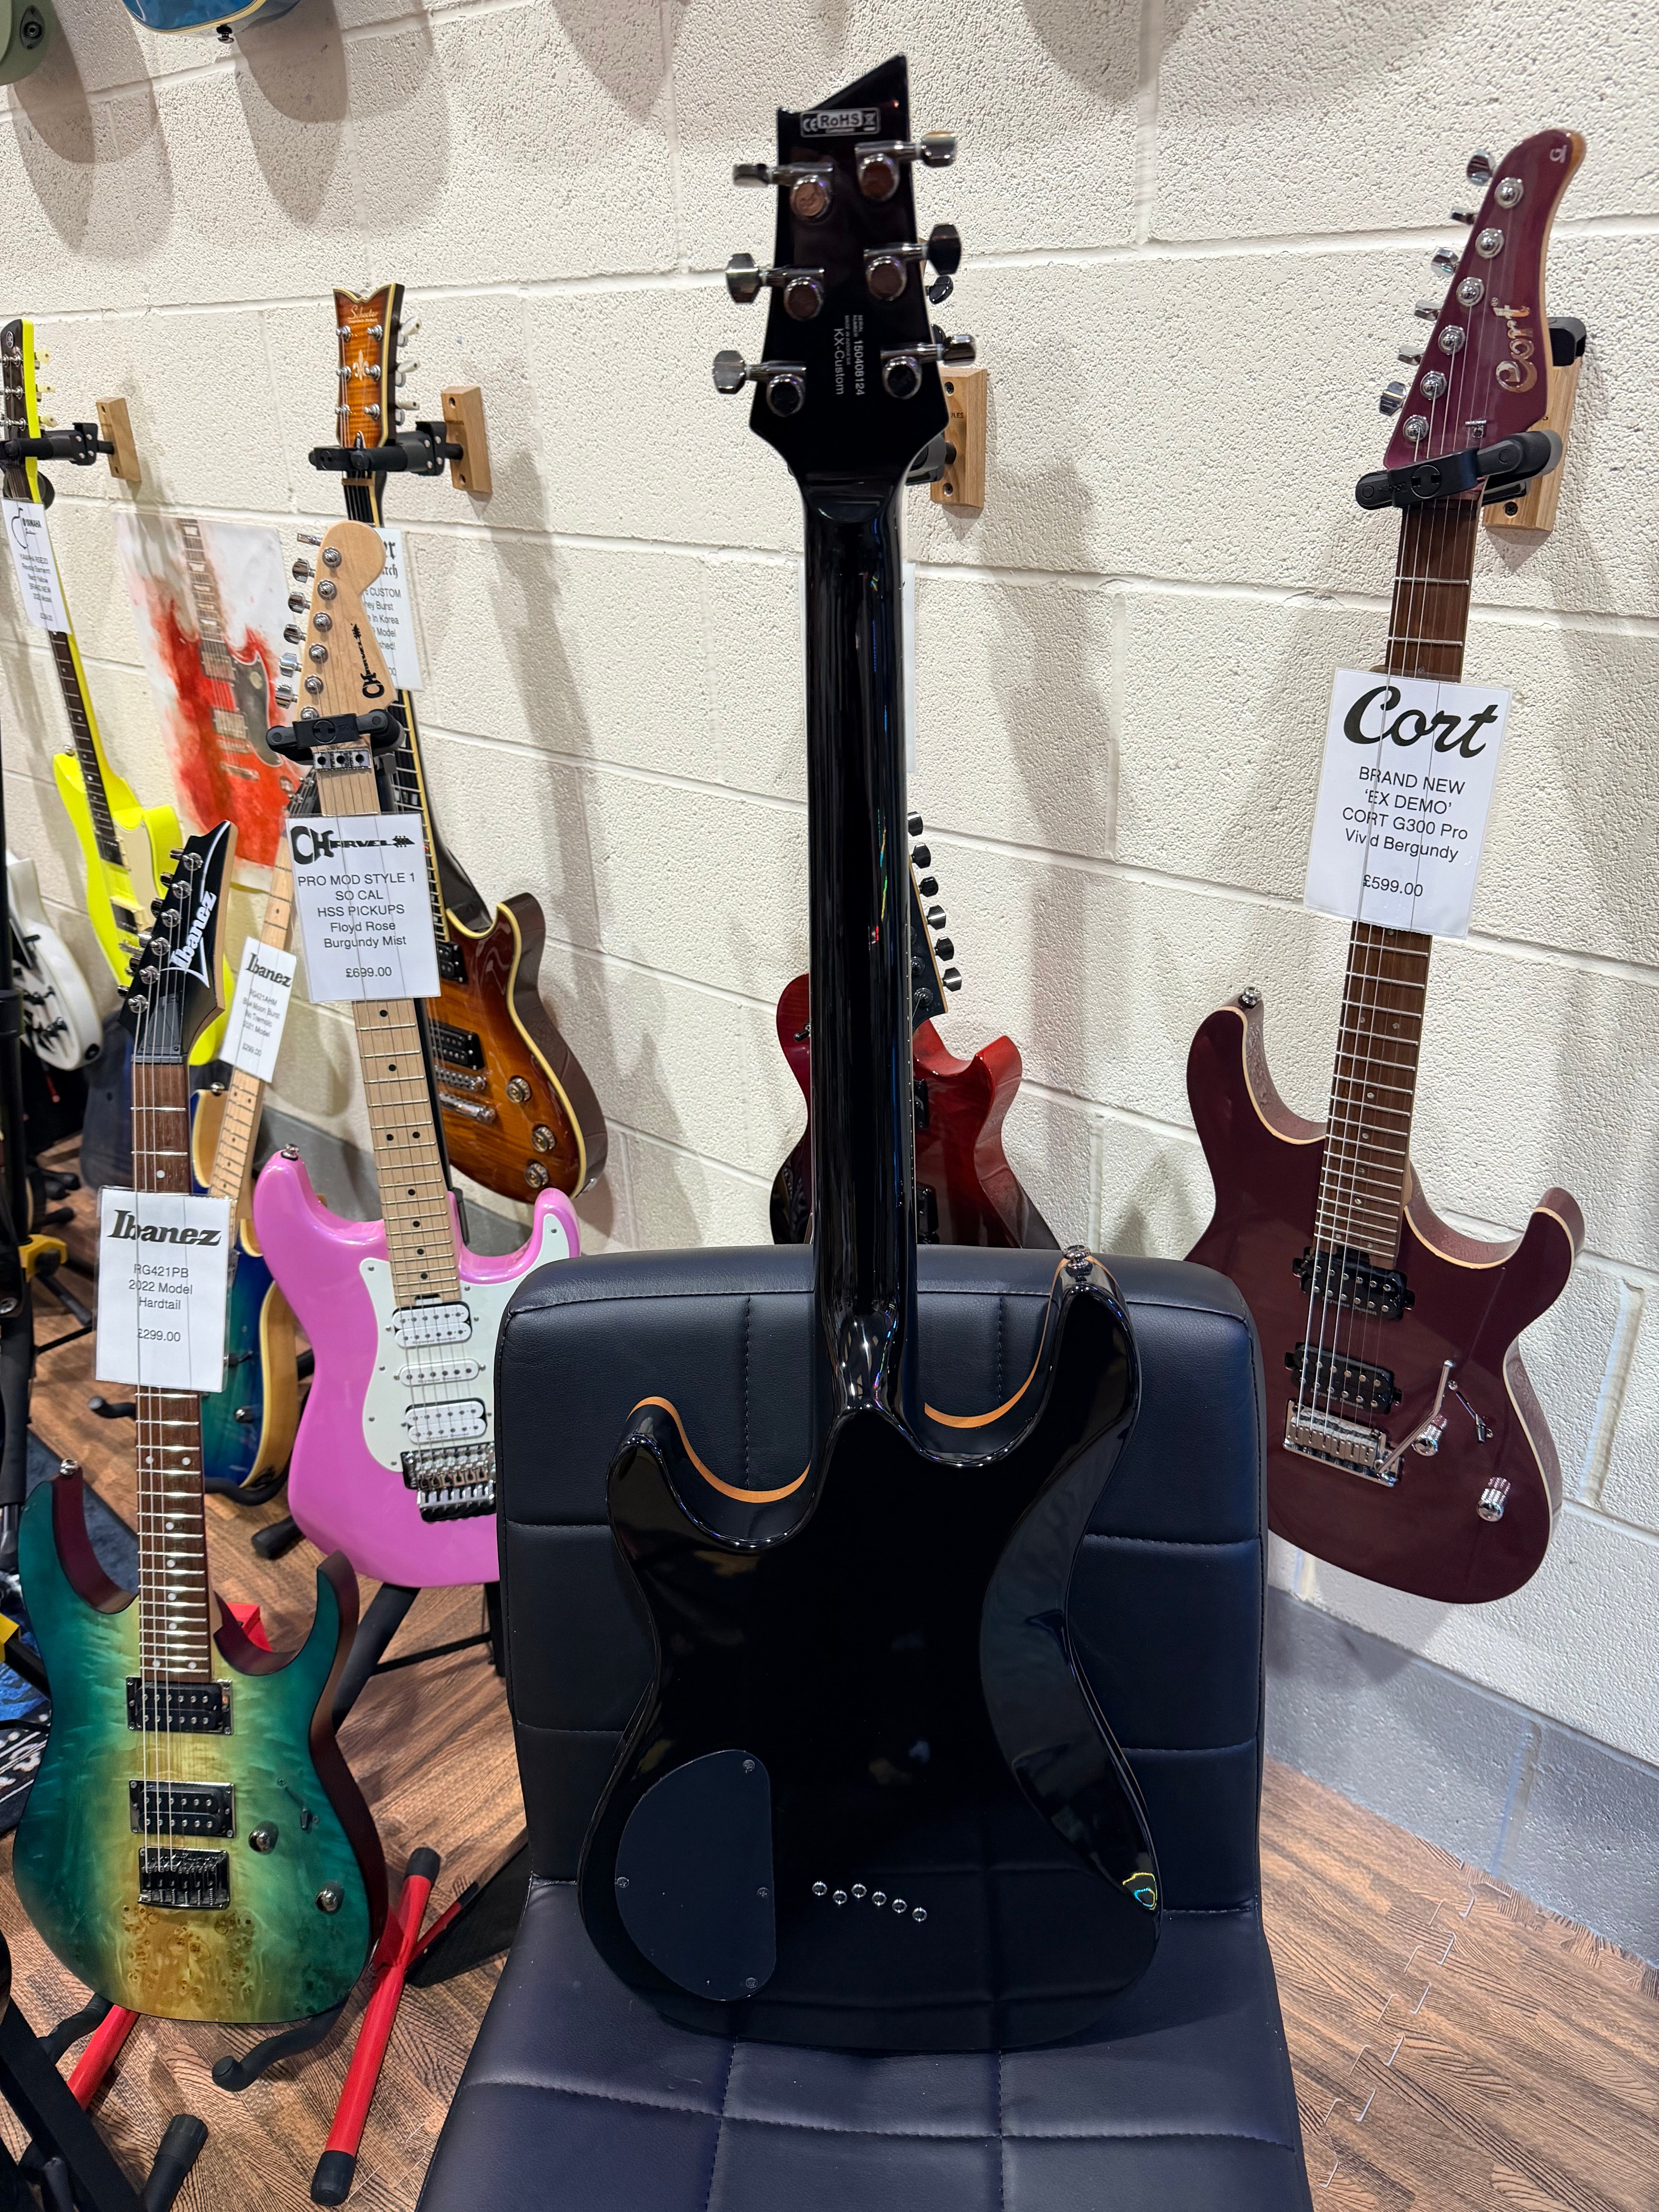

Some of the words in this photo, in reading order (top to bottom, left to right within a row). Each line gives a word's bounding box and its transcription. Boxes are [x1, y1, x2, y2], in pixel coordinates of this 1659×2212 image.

[820, 113, 859, 126] RoHS
[1493, 304, 1538, 393] Cort
[833, 328, 845, 395] KX-Custom
[854, 340, 866, 396] 150408124
[369, 587, 402, 598] CUSTOM
[376, 601, 394, 611] Burst
[379, 614, 400, 625] Korea
[376, 627, 397, 637] Model
[1343, 685, 1499, 758] Cort
[1359, 766, 1418, 788] BRAND
[1422, 776, 1466, 795] NEW
[1342, 807, 1389, 827] CORT
[1393, 816, 1436, 835] G300
[1440, 823, 1468, 840] Pro
[1346, 828, 1379, 847] Vivd
[1383, 836, 1459, 863] Bergundy
[298, 876, 326, 886] PRO
[330, 874, 361, 885] MOD
[364, 872, 405, 884] STYLE
[409, 872, 415, 882] 1
[1363, 874, 1423, 897] £599.00
[335, 890, 354, 901] SO
[357, 890, 384, 900] CAL
[317, 907, 345, 917] HSS
[348, 904, 405, 916] PICKUPS
[169, 891, 217, 970] Ibanez
[330, 921, 362, 934] Floyd
[366, 921, 396, 931] Rose
[324, 936, 379, 950] Burgundy
[382, 936, 407, 946] Mist
[246, 952, 292, 988] Ibanez
[345, 966, 392, 978] £699.00
[107, 1209, 222, 1246] Ibanez
[134, 1264, 189, 1278] RG421PB
[129, 1279, 155, 1291] 2022
[158, 1282, 193, 1295] Model
[139, 1297, 181, 1310] Hardtail
